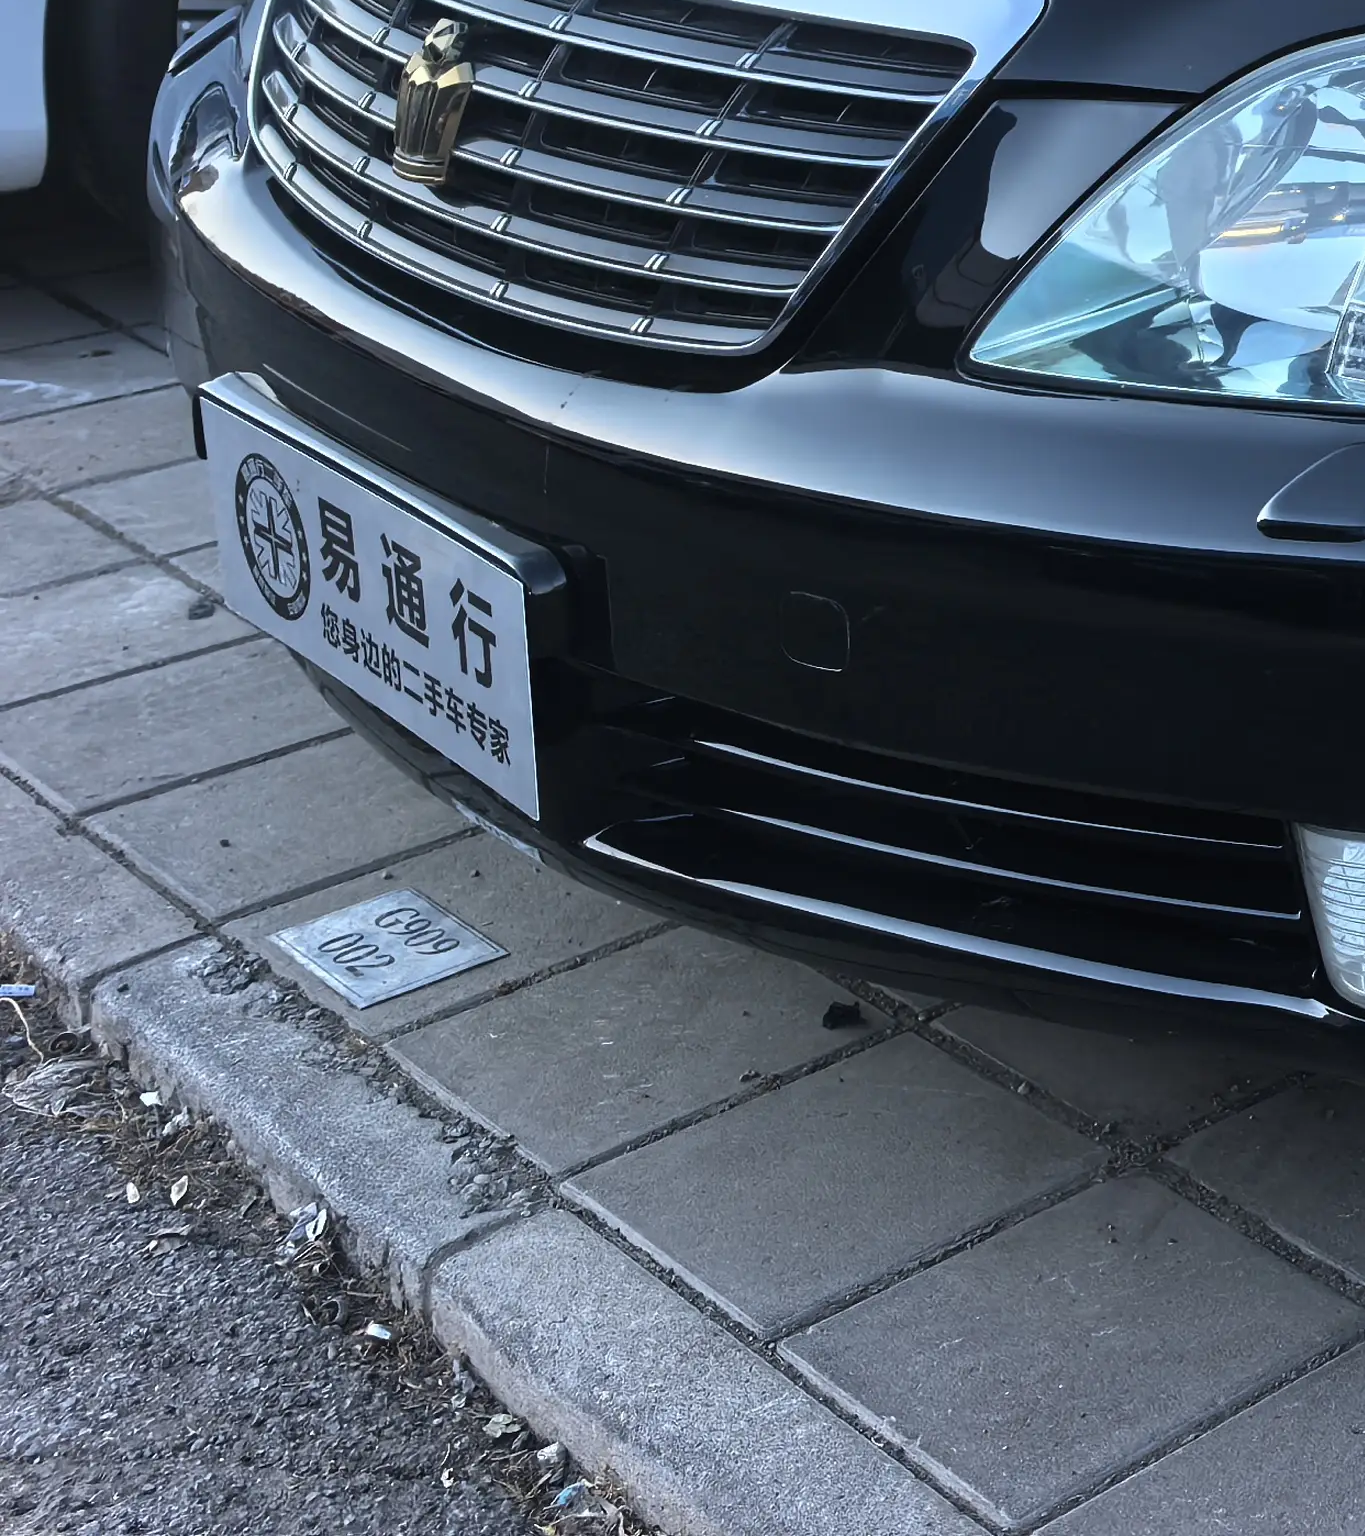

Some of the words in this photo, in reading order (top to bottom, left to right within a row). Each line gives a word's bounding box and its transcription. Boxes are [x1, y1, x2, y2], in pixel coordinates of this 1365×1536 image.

[317, 496, 497, 689] 易通行
[320, 602, 512, 768] 您身边的二手车专家
[317, 932, 397, 977] 002
[374, 906, 461, 956] G909
